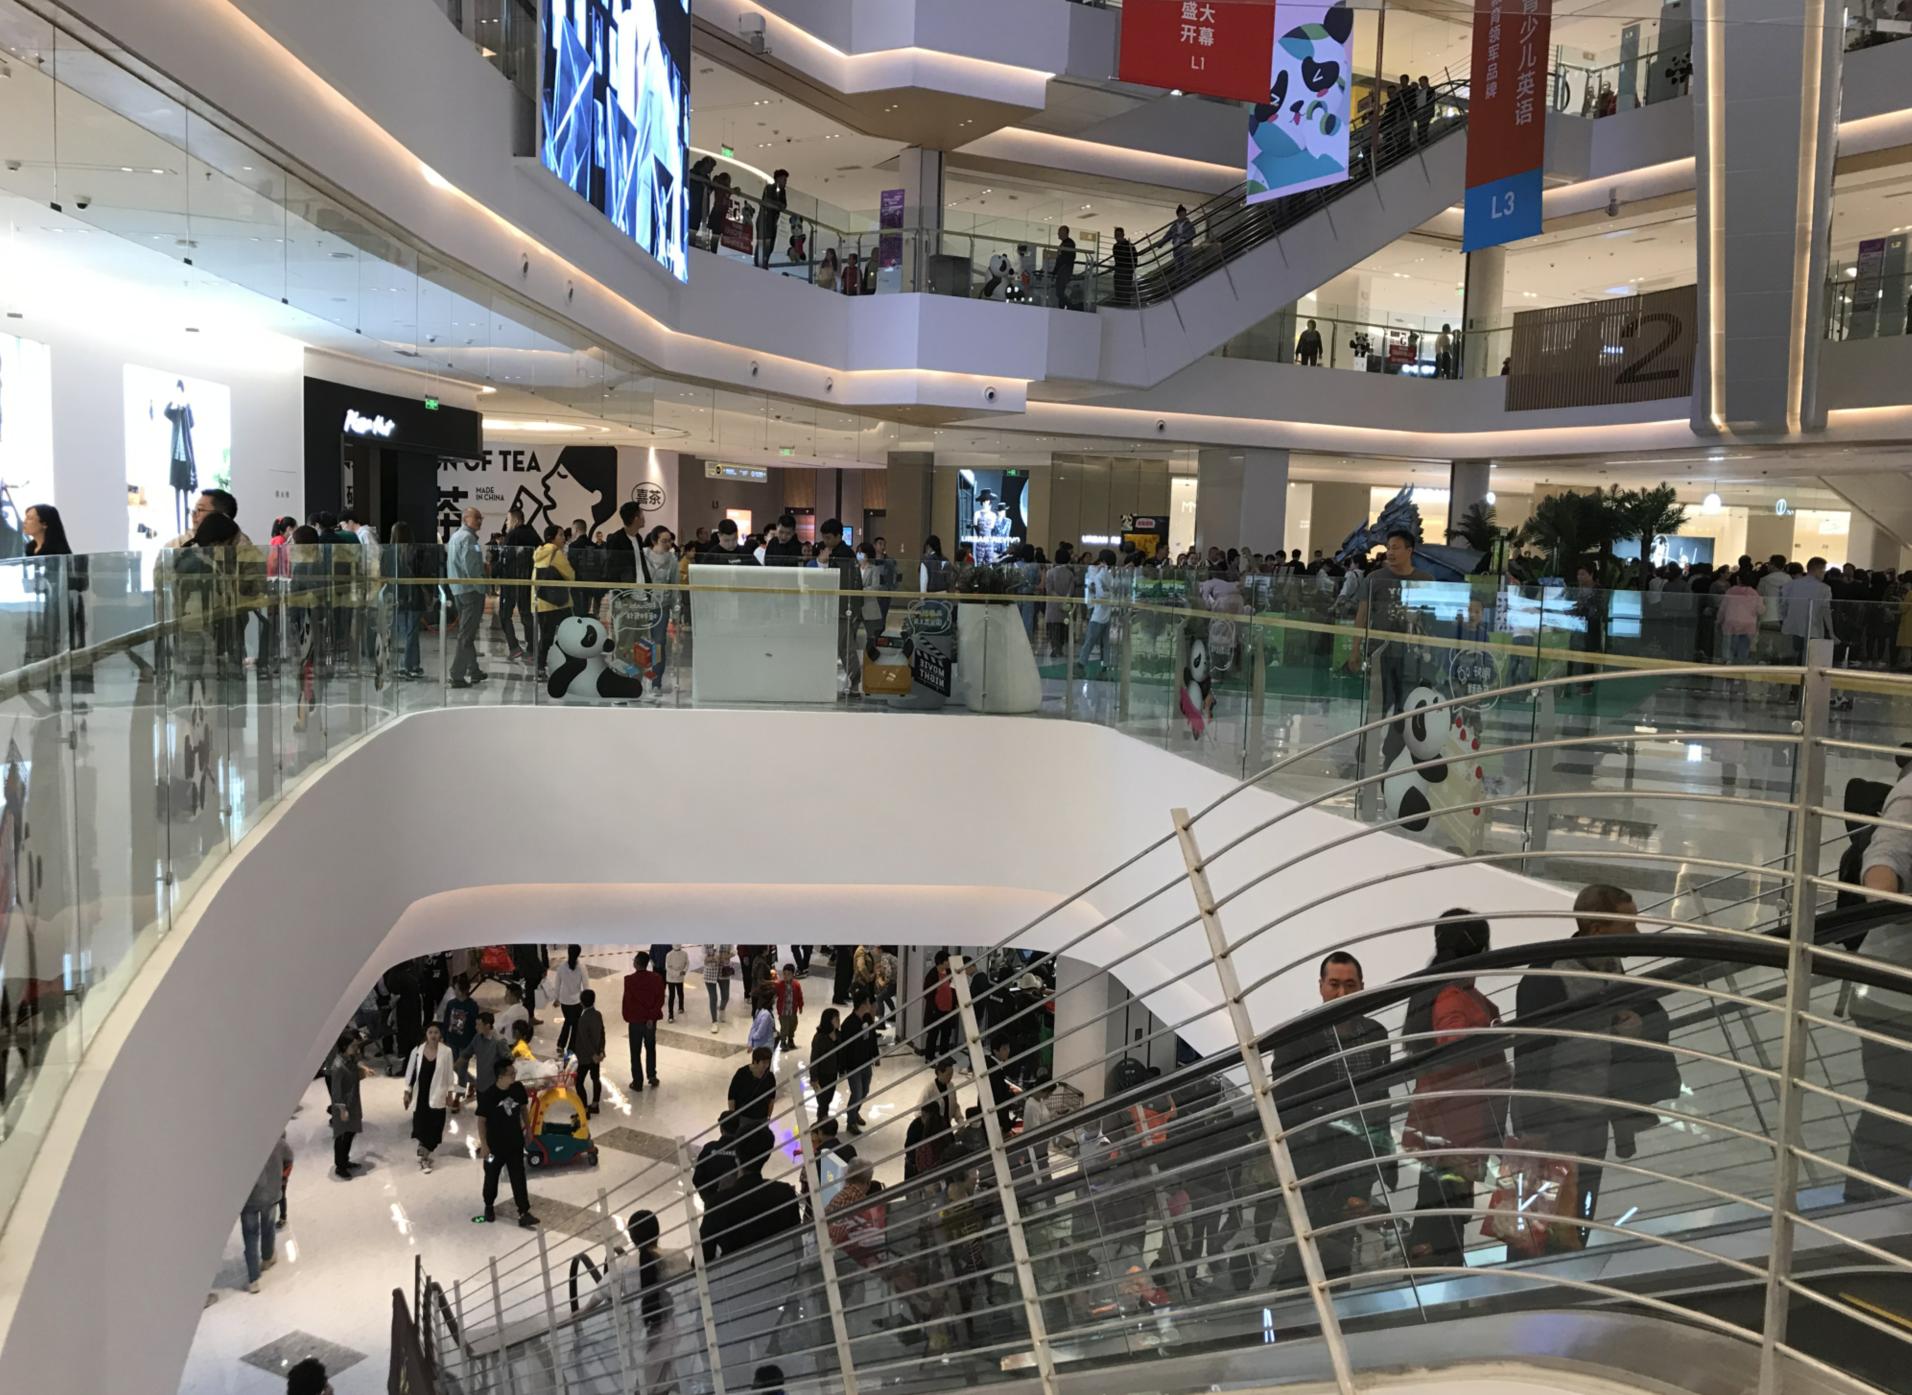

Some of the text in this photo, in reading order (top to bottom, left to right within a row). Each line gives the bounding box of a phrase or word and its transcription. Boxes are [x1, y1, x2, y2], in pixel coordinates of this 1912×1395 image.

[1181, 1, 1216, 24] 盛大
[1180, 24, 1215, 47] 开幕
[1191, 56, 1205, 70] L1
[1491, 191, 1516, 219] L3
[1615, 312, 1683, 385] 2
[498, 450, 542, 472] TEA
[475, 486, 495, 494] MADE
[636, 488, 662, 505] 喜茶
